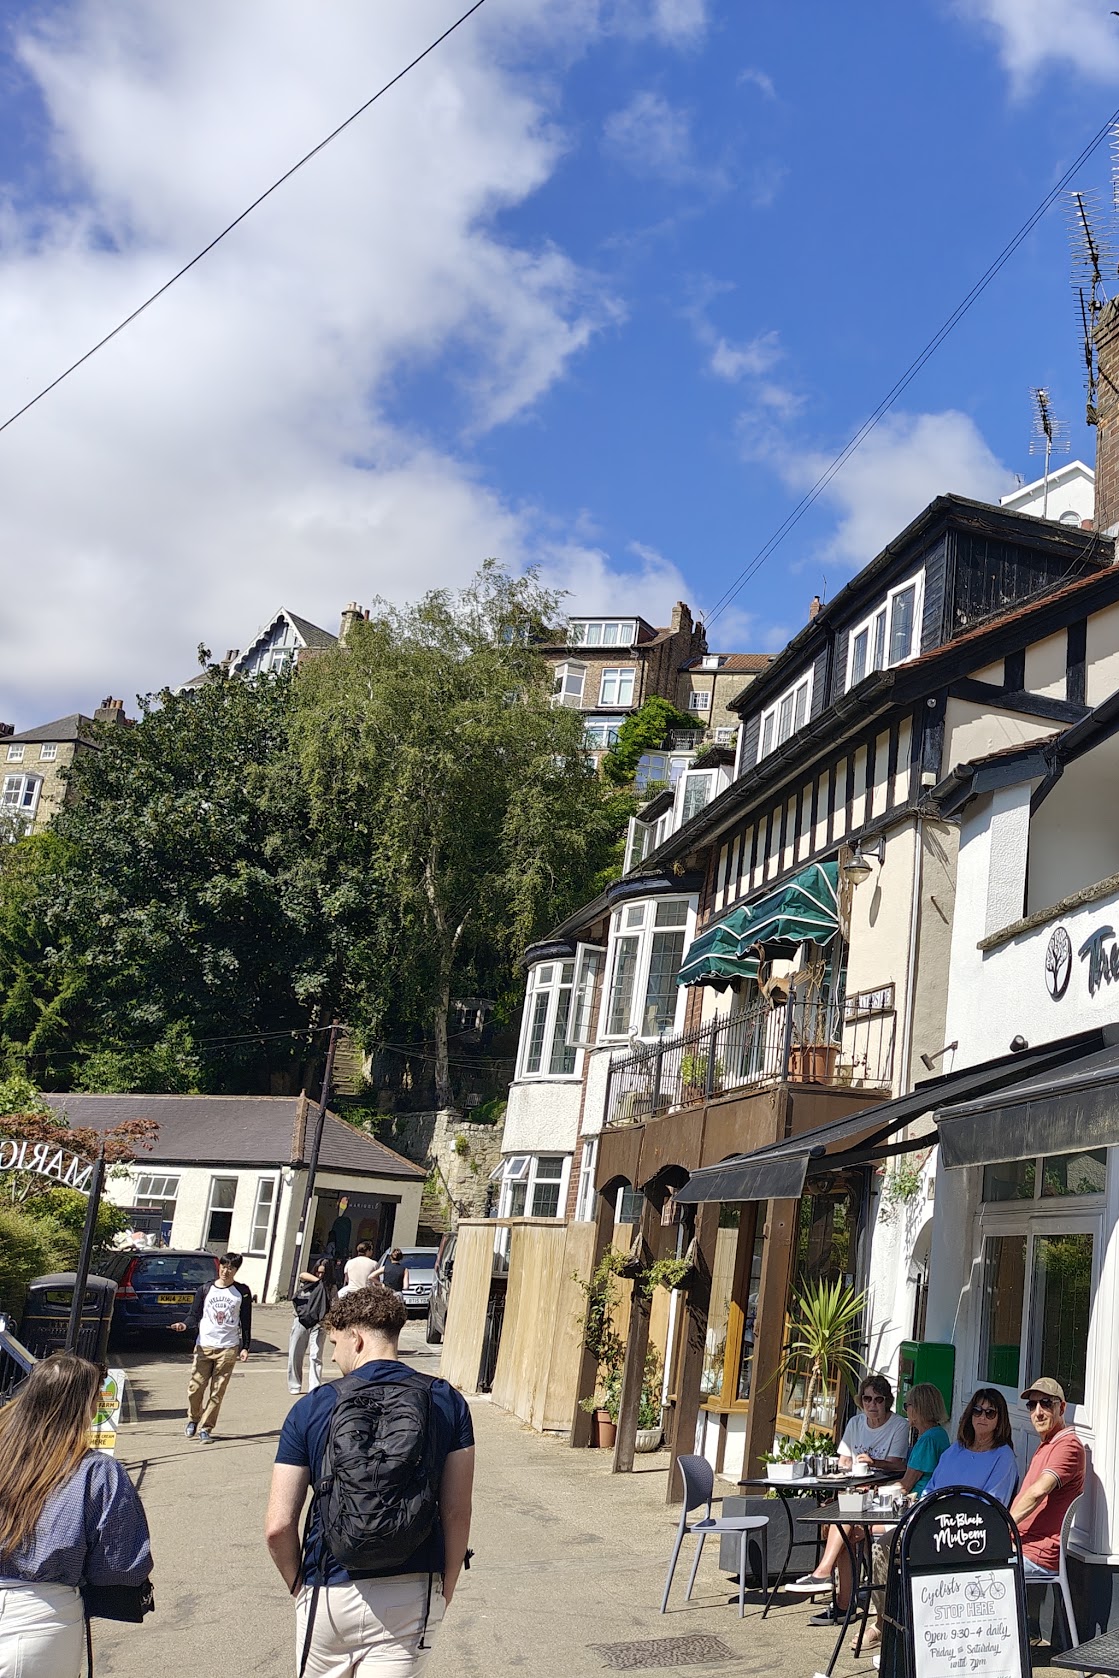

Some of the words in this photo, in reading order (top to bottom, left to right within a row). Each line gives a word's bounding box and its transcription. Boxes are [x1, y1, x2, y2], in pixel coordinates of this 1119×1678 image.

[209, 1296, 234, 1305] HELLFIRE
[934, 1514, 956, 1528] The
[956, 1513, 984, 1528] Black
[933, 1527, 987, 1555] Mulberry
[921, 1577, 961, 1606] Cyclists
[934, 1604, 965, 1620] STOP
[966, 1601, 996, 1617] HERE
[924, 1630, 948, 1647] Open
[986, 1622, 1011, 1640] daily
[930, 1647, 956, 1661] Friday
[966, 1642, 1001, 1656] Saturday
[950, 1656, 967, 1668] until
[970, 1658, 987, 1671] 7pm
